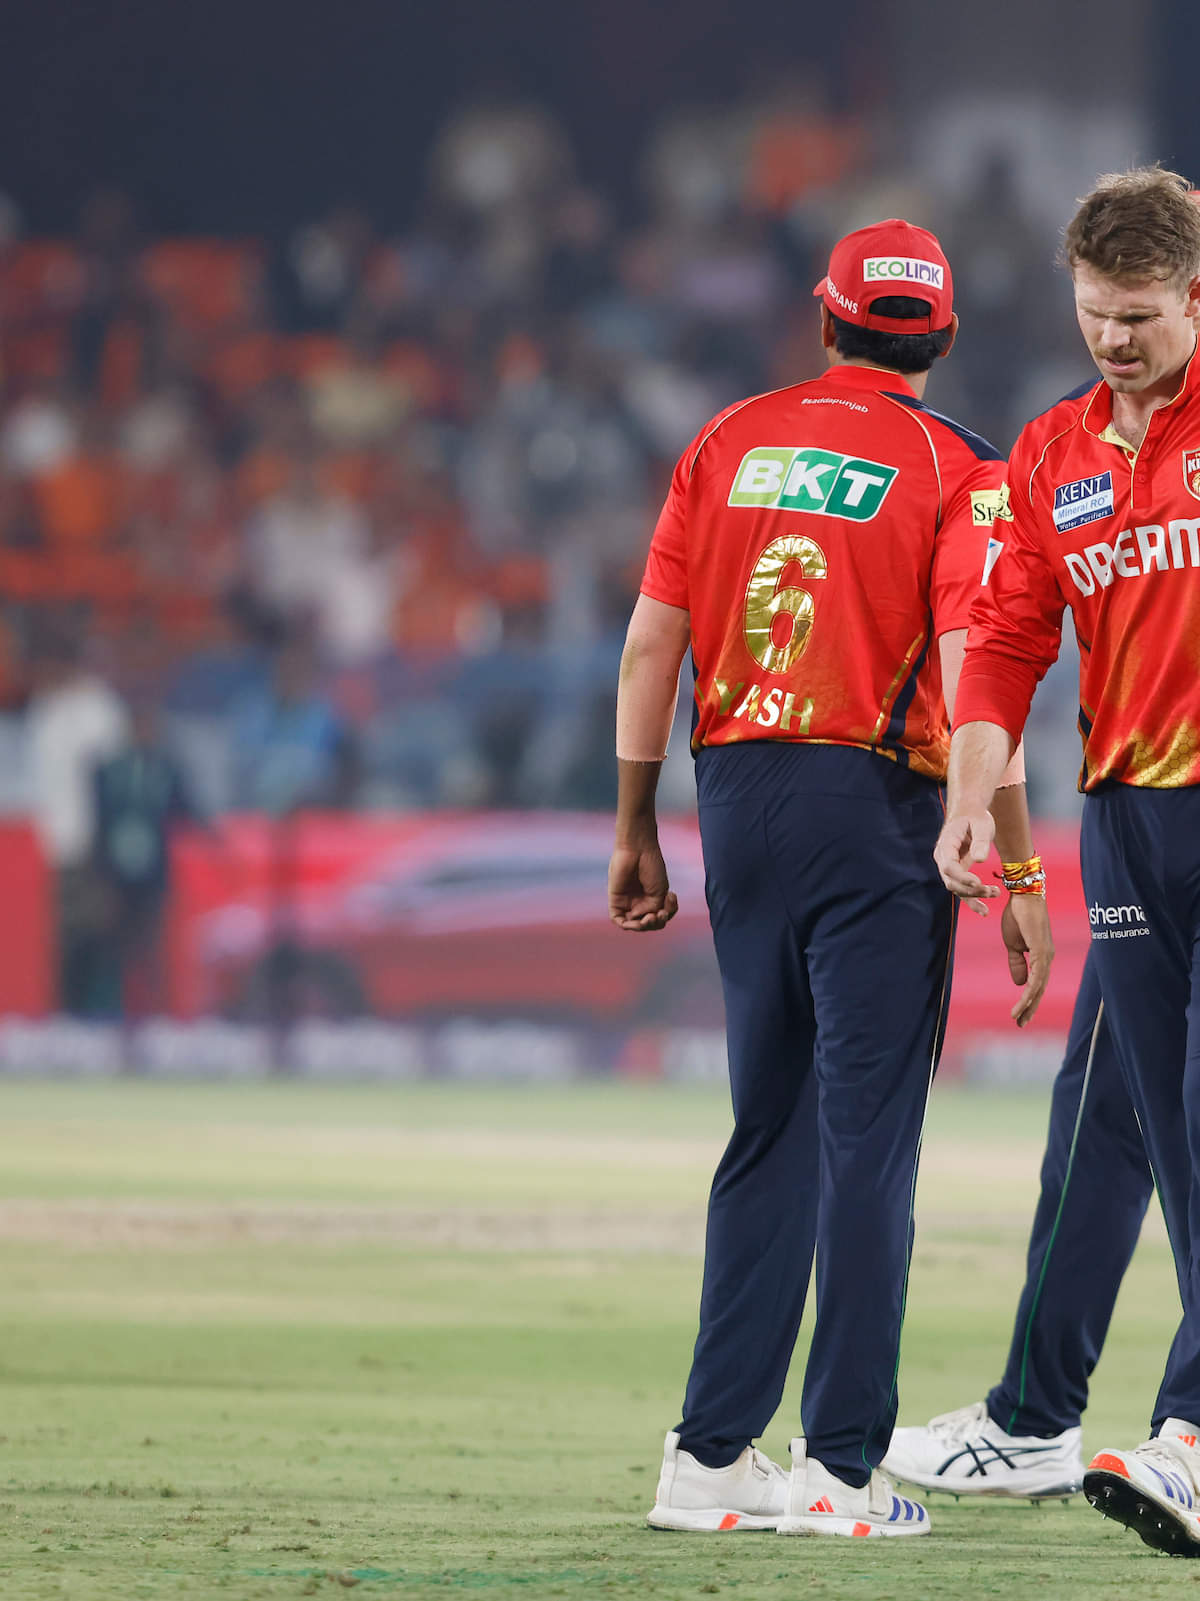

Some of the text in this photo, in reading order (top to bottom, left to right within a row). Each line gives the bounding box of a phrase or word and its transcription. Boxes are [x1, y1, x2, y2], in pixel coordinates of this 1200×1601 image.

[867, 260, 941, 285] ECOLINK
[736, 458, 886, 507] BKT
[1060, 476, 1103, 504] KENT
[743, 534, 828, 674] 6
[714, 677, 815, 735] YASH
[1110, 927, 1150, 939] Insurance
